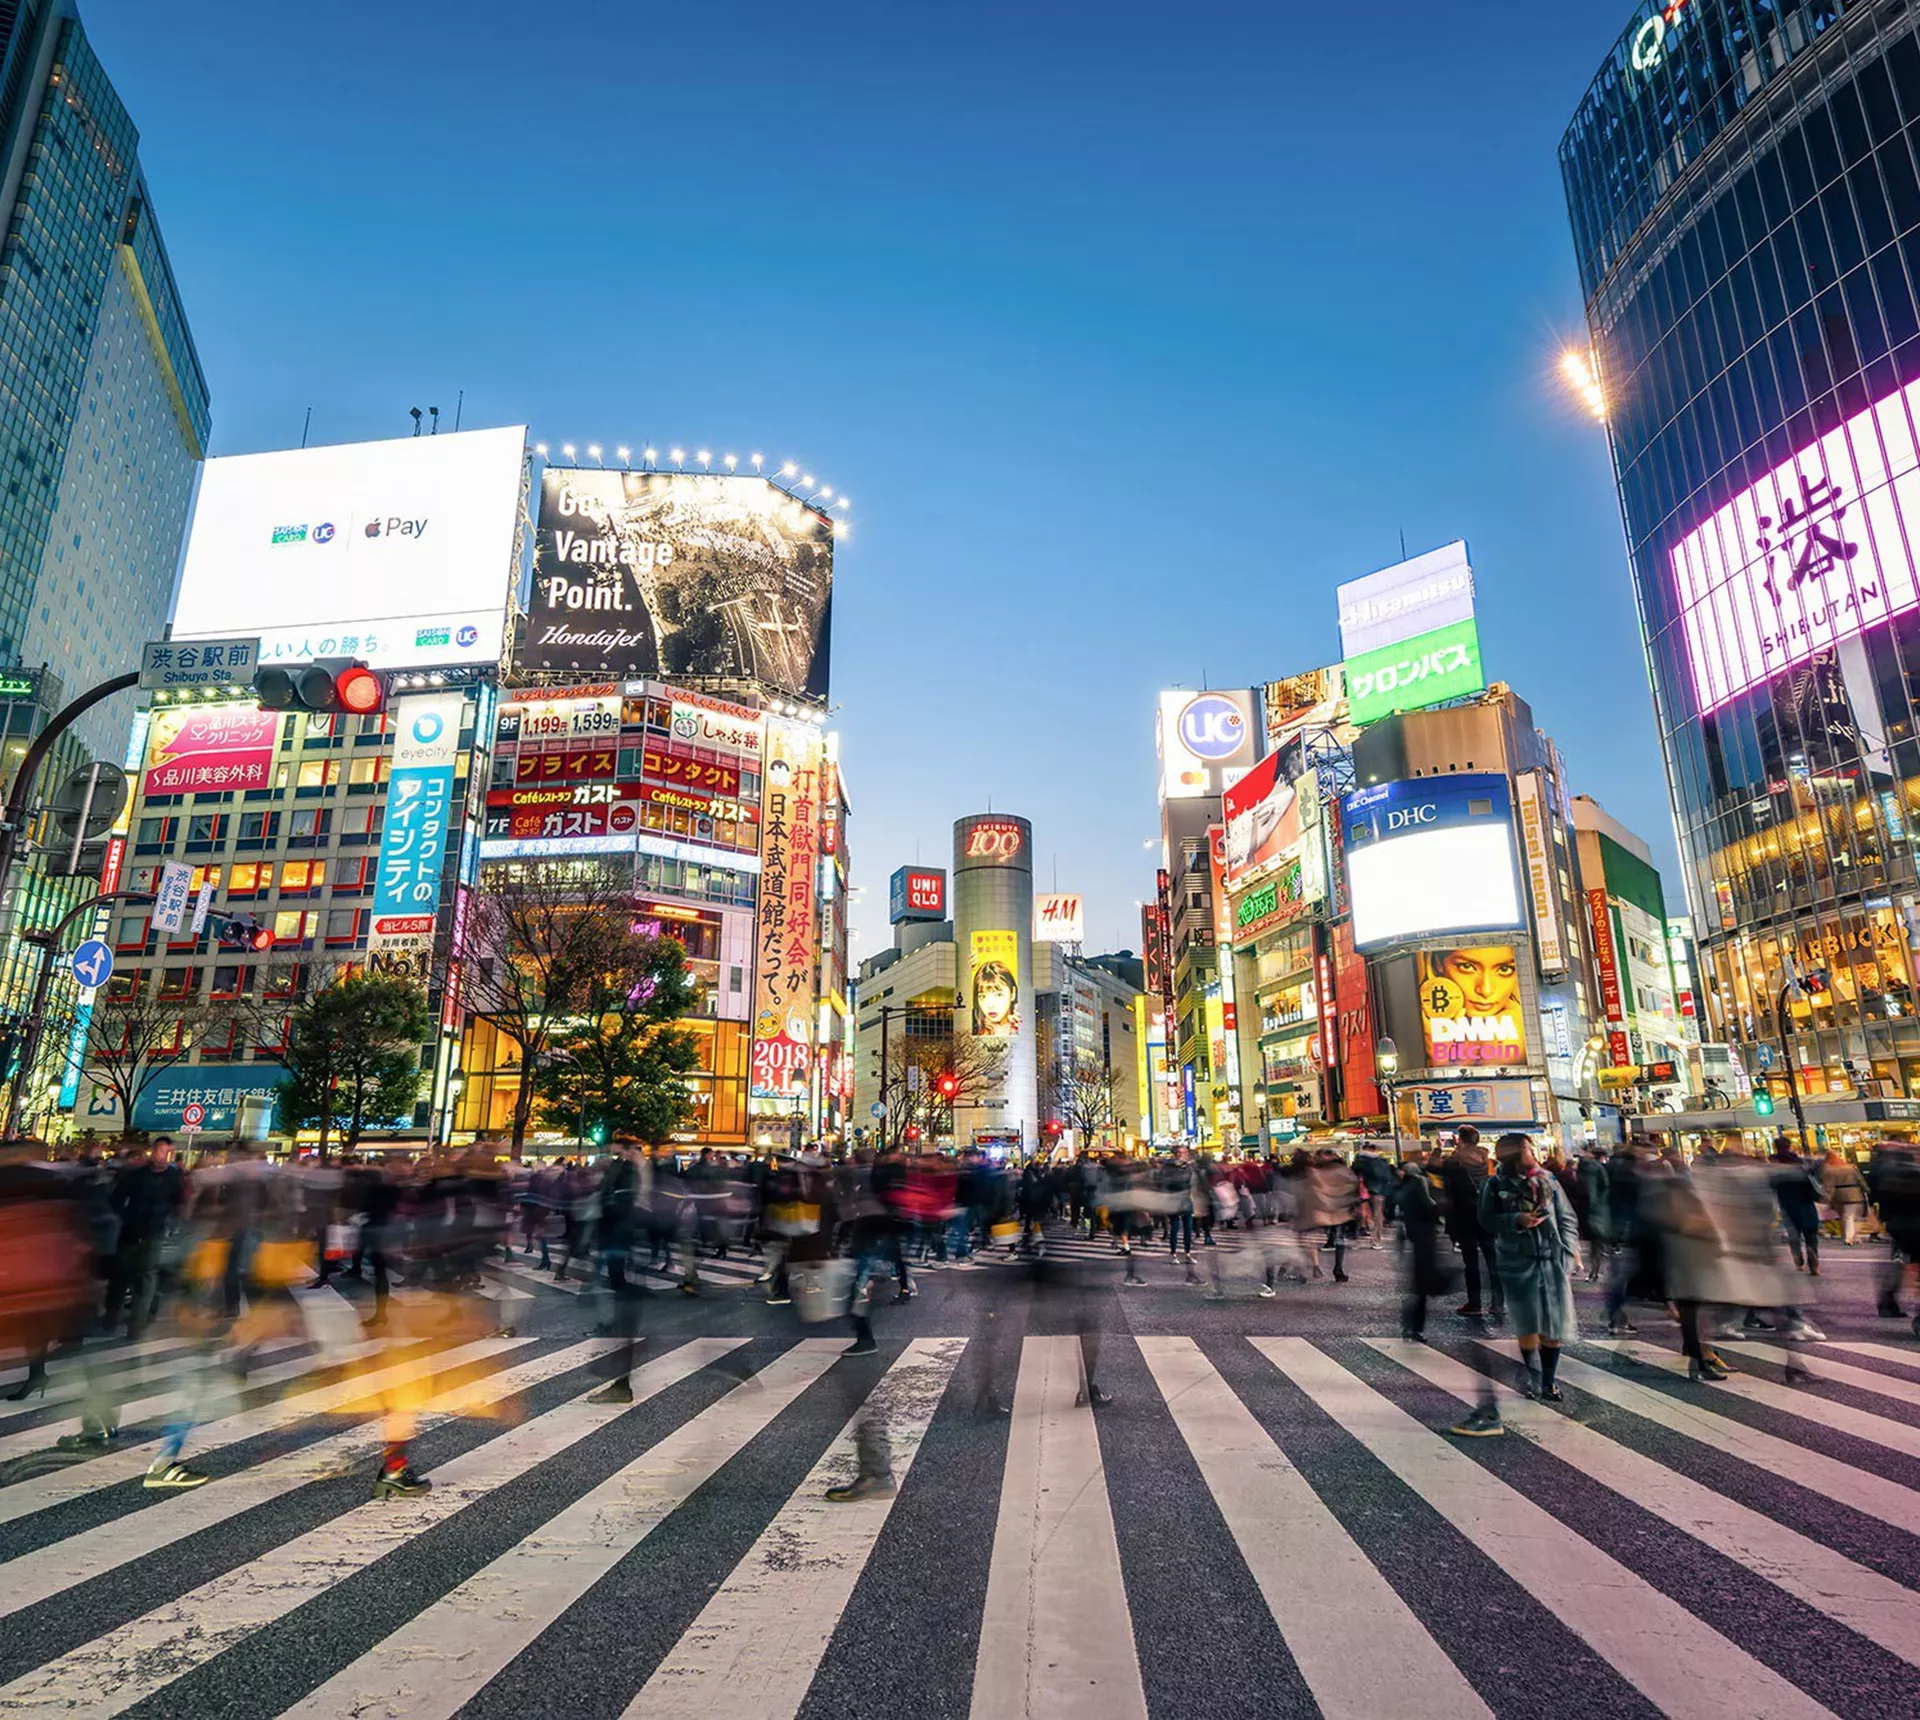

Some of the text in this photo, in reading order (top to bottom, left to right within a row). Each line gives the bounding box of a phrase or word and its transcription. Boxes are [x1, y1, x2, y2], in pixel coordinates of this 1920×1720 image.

[386, 517, 428, 539] Pay
[1756, 474, 1859, 607] 渋
[555, 531, 674, 572] Vantage
[548, 576, 633, 611] Point.
[1763, 580, 1880, 655] SHIBUTAN
[420, 635, 444, 646] CARD
[537, 623, 644, 654] HondaJet
[151, 645, 250, 669] 渋谷駅前
[163, 671, 208, 684] Shibuya
[1351, 643, 1472, 700] サロンパス
[206, 727, 264, 745] クリニック
[500, 717, 519, 730] 9F
[703, 720, 760, 750] しゃぶ葉
[1185, 711, 1241, 743] UC
[401, 746, 448, 761] eyecity
[519, 753, 612, 777] プライス
[162, 763, 263, 787] 品川美容外科
[644, 753, 737, 789] コンタクト
[573, 784, 622, 805] ガスト
[515, 815, 541, 828] Café
[542, 811, 602, 837] ガスト
[708, 800, 751, 823] ガスト
[1387, 803, 1437, 830] DHC
[488, 818, 510, 834] 7F
[976, 823, 1019, 832] SHIBUYA
[384, 779, 422, 903] アイシティ
[412, 778, 445, 902] コンタクトの
[966, 829, 1020, 863] 109
[1522, 793, 1549, 920] Taisei neon
[785, 764, 815, 993] 打首獄門同好会が
[912, 878, 937, 892] UNI
[165, 868, 189, 927] 渋谷駅前
[762, 793, 789, 1006] 日本武道館だって。
[912, 892, 939, 907] QLO
[1043, 899, 1077, 921] H&M
[1430, 1014, 1520, 1043] DMM
[754, 1041, 809, 1070] 2018
[1432, 1041, 1521, 1061] Bitcoin
